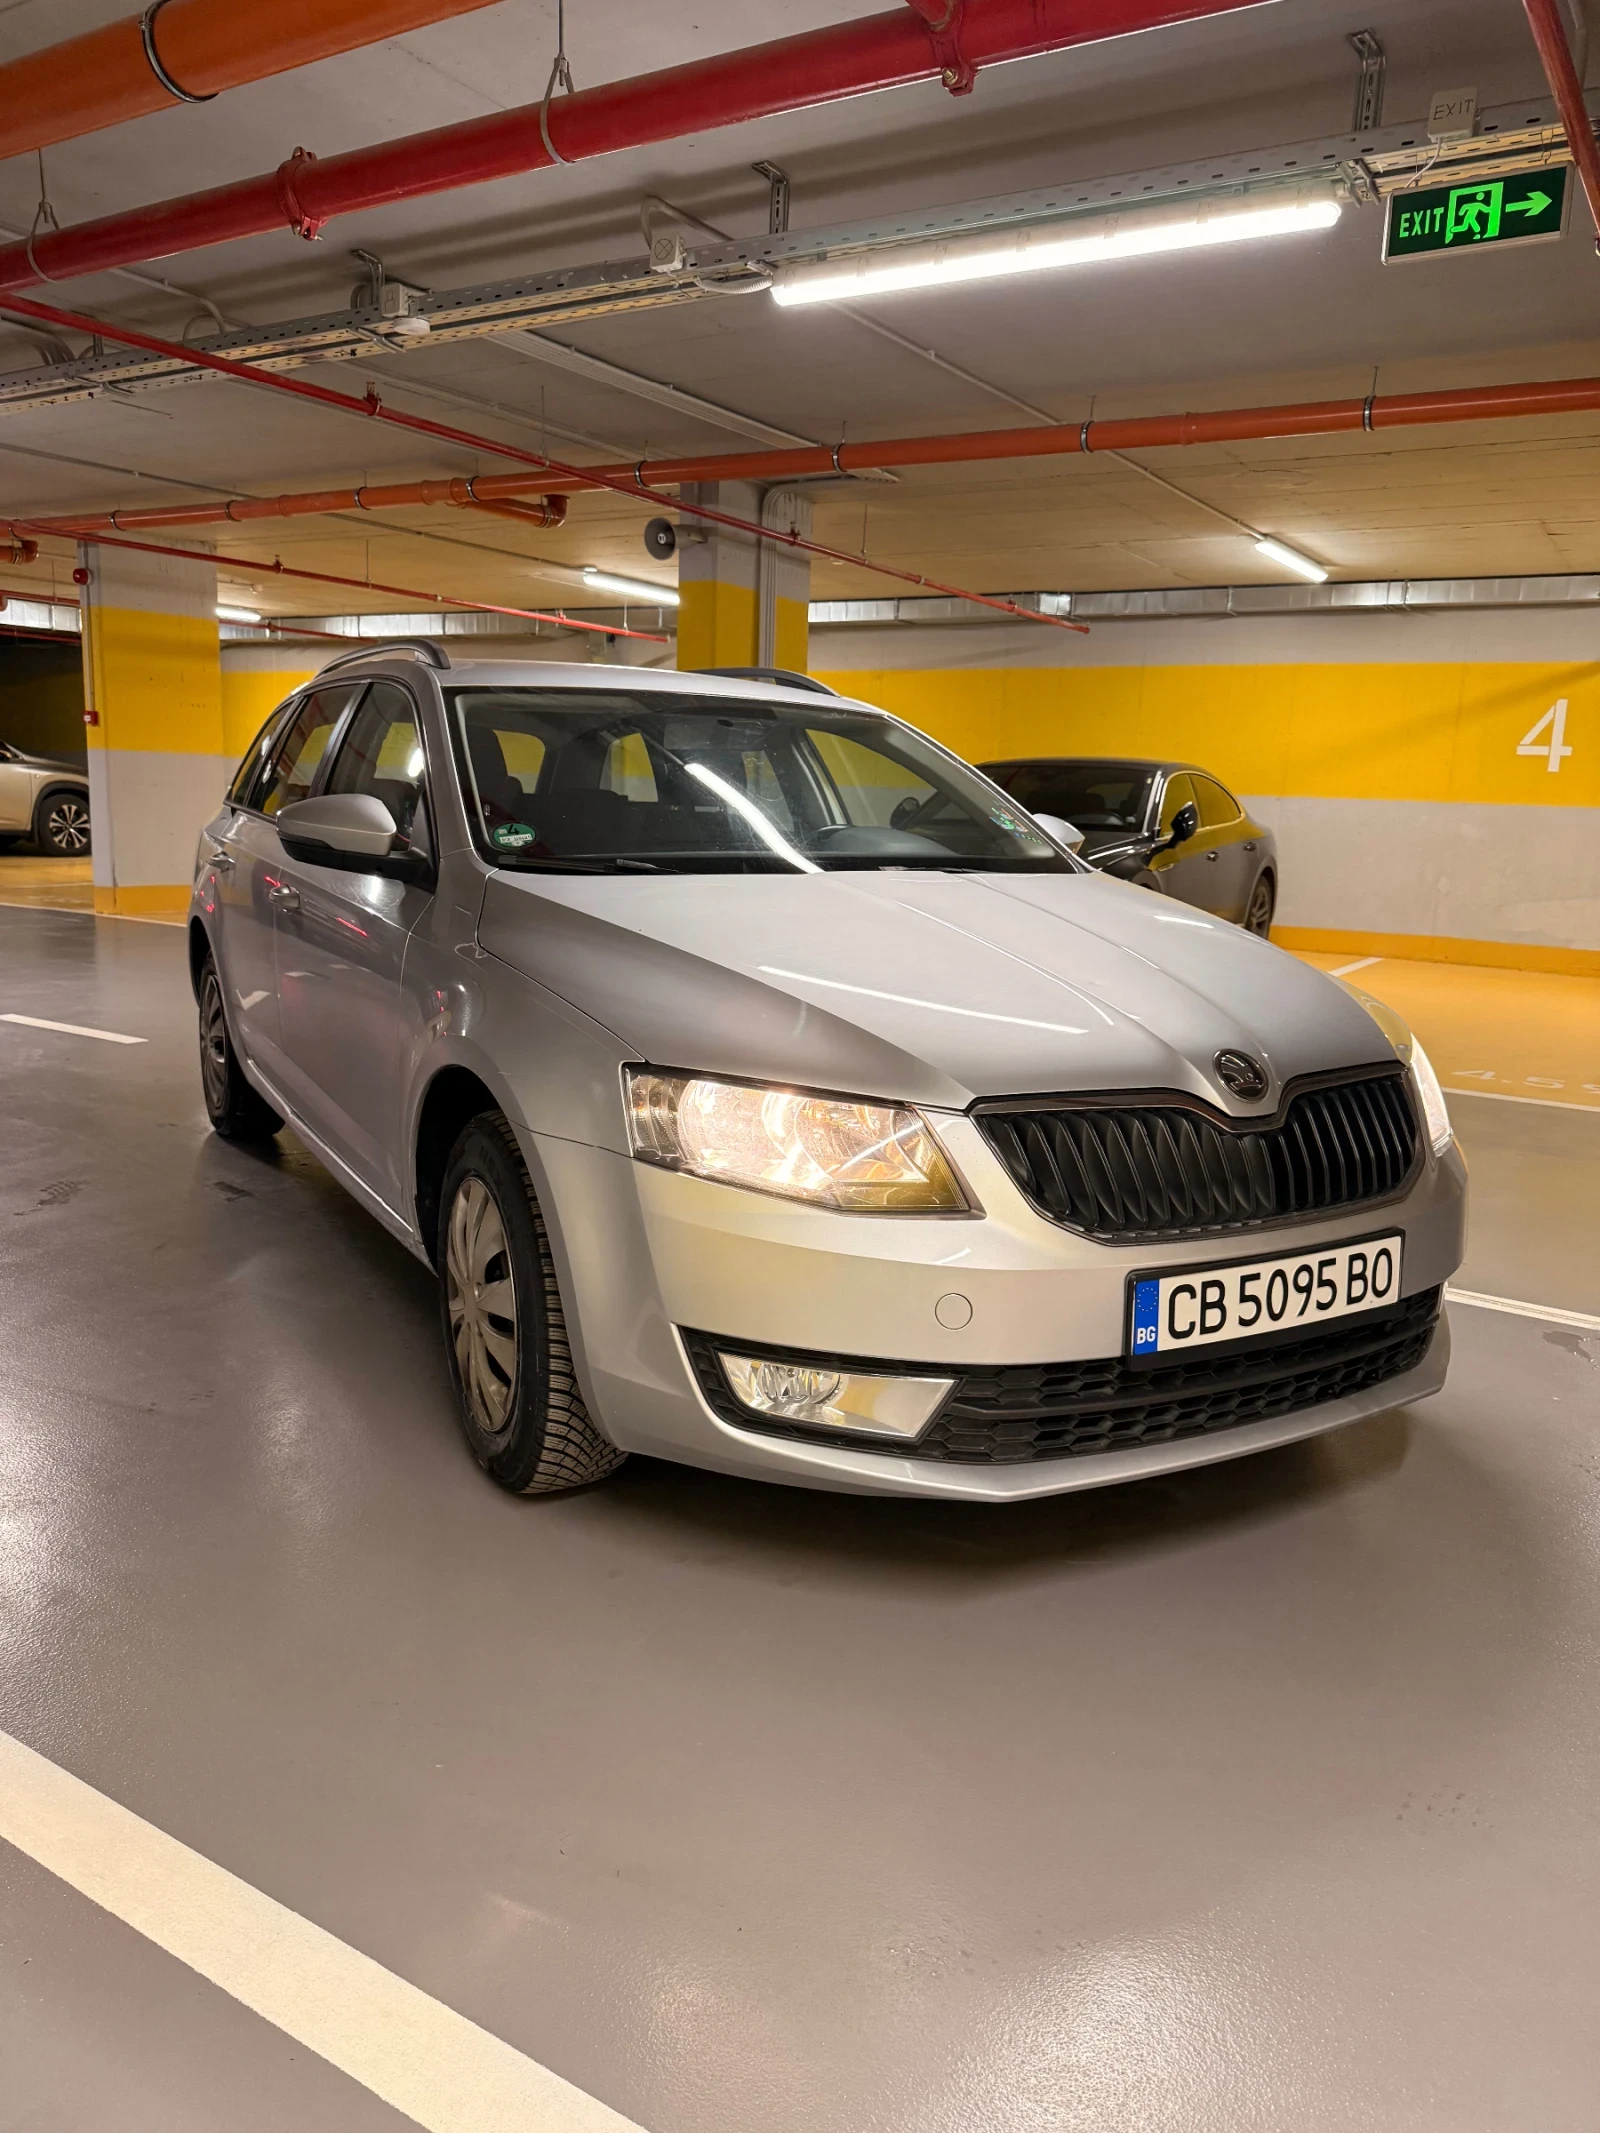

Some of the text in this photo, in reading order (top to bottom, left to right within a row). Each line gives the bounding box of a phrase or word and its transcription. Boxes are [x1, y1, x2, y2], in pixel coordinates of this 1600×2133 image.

[1433, 99, 1474, 121] EXIT
[1399, 207, 1444, 238] EXIT
[1516, 698, 1573, 773] 4
[507, 824, 520, 835] 4
[1168, 1247, 1393, 1340] CB 5095 BO
[1136, 1326, 1156, 1345] BG
